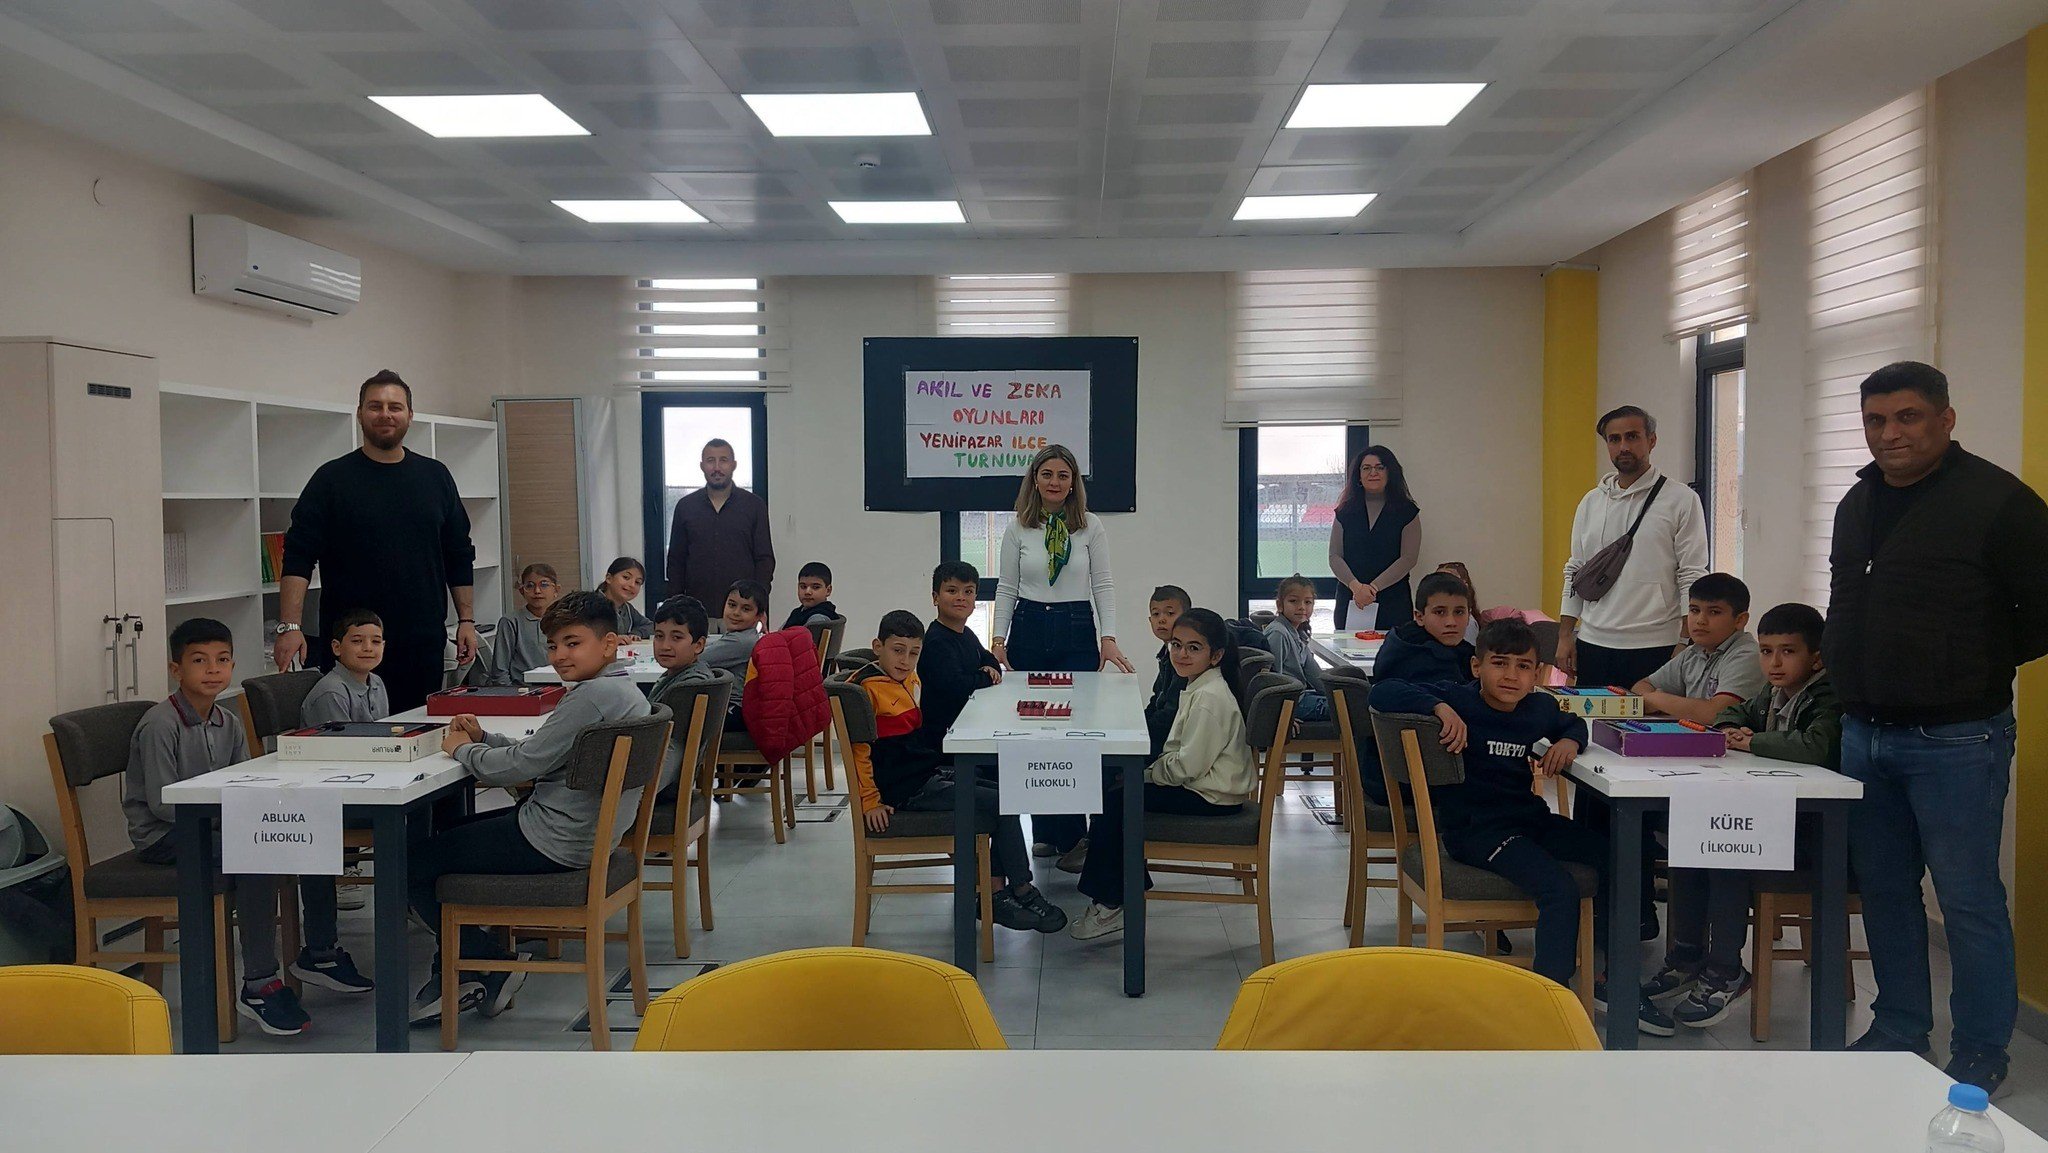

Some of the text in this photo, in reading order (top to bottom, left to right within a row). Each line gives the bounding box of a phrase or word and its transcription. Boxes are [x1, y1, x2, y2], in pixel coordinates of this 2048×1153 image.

[917, 380, 1062, 399] AKIL VE ZEKA
[952, 408, 1044, 425] OYUNLARI
[919, 432, 1003, 449] YENİPAZAR
[1487, 740, 1527, 758] TOKYO
[1027, 761, 1073, 771] PENTAGO
[1031, 777, 1071, 788] İLKOKUL
[261, 812, 306, 824] ABLUKA
[1710, 814, 1754, 831] KÜRE
[260, 830, 307, 843] İLKOKUL
[1708, 840, 1756, 854] İLKOKUL
